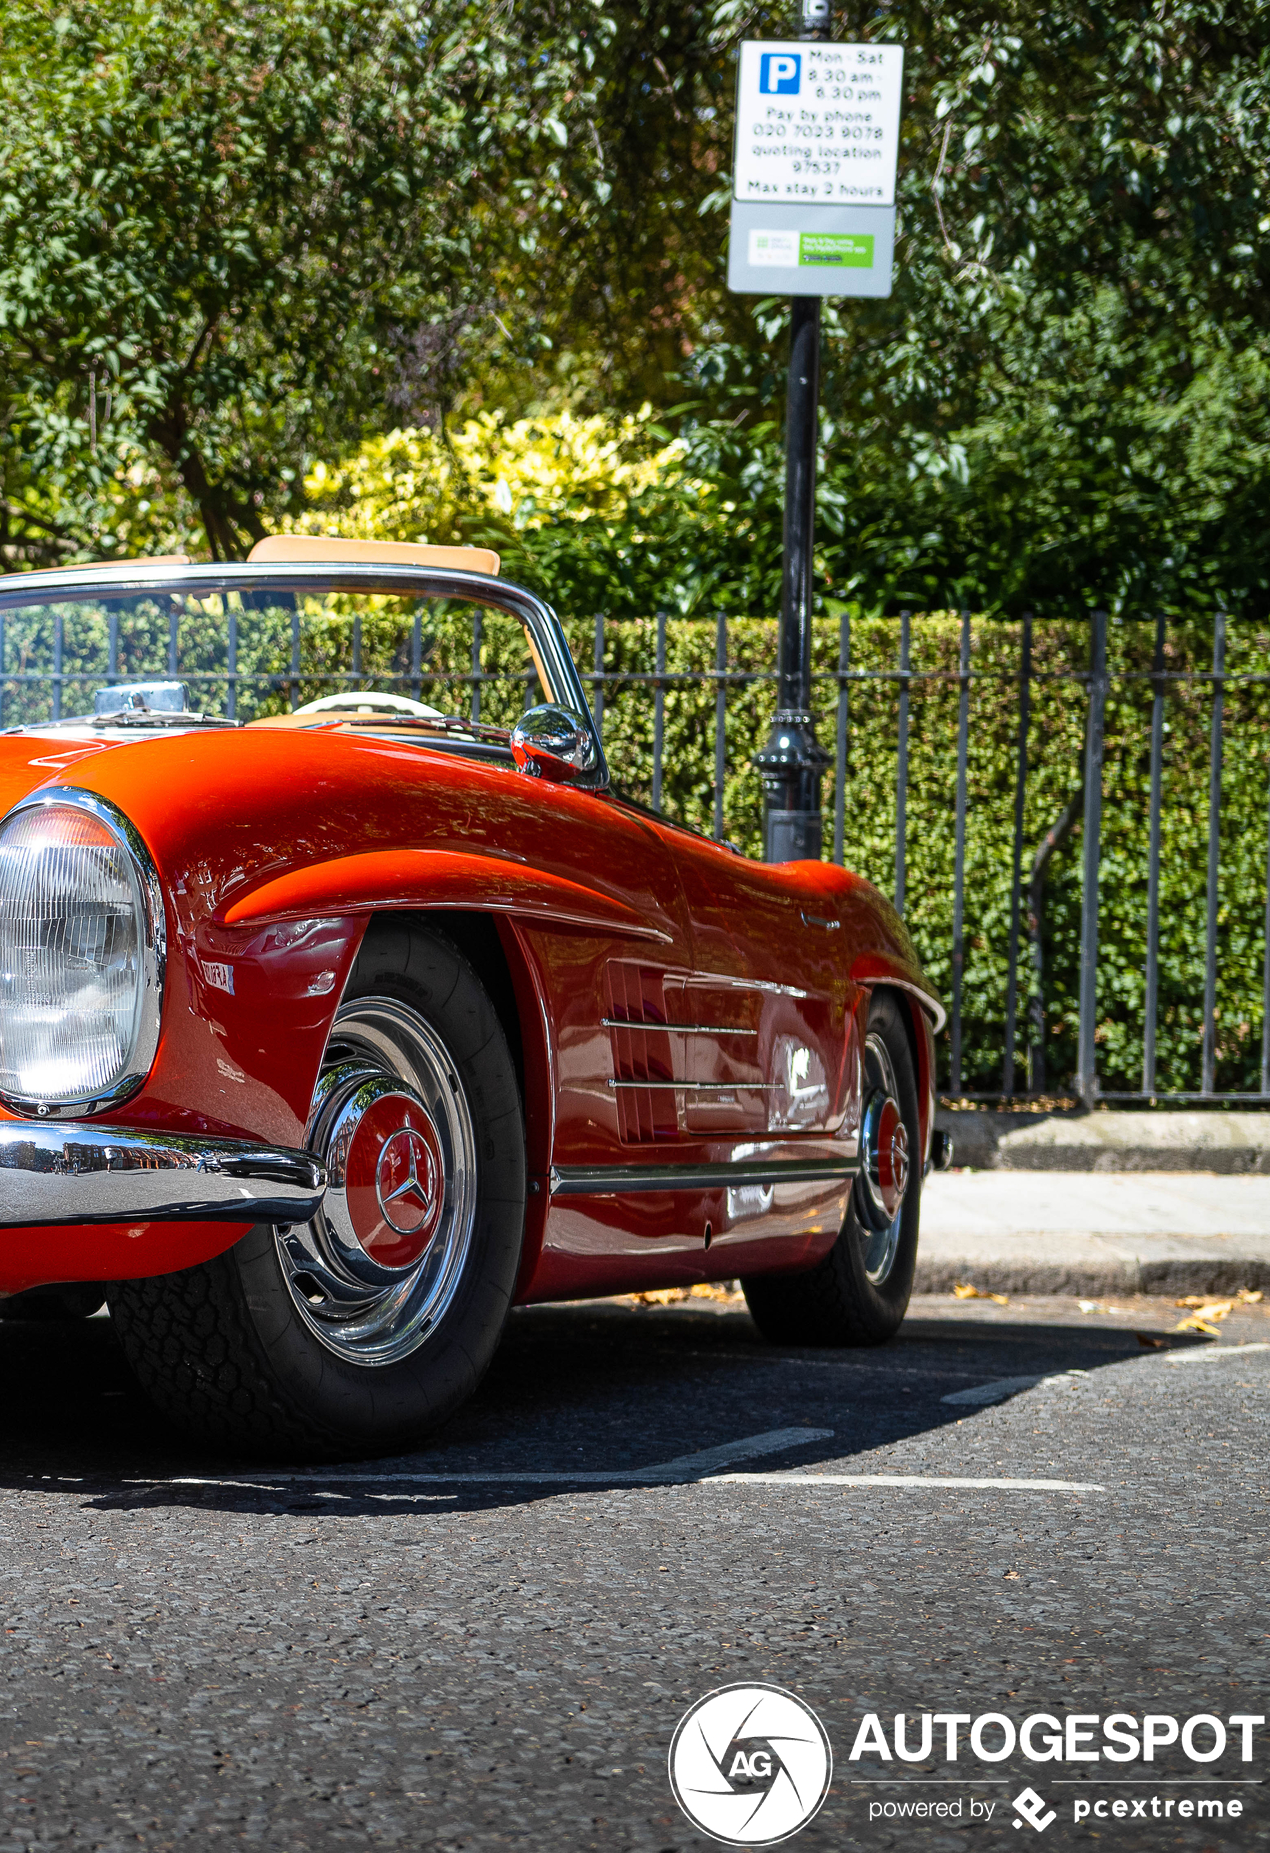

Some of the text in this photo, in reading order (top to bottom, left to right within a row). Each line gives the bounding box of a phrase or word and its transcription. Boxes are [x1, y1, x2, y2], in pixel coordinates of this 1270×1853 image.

[808, 49, 843, 65] Mon
[856, 50, 884, 66] Sat
[768, 56, 797, 93] P
[850, 72, 873, 84] am
[857, 89, 882, 103] pm
[766, 107, 872, 124] Pay by phone
[753, 123, 786, 137] 020
[793, 125, 834, 139] 7023
[752, 144, 882, 160] quoting location
[747, 179, 884, 198] Max stay 2 hours
